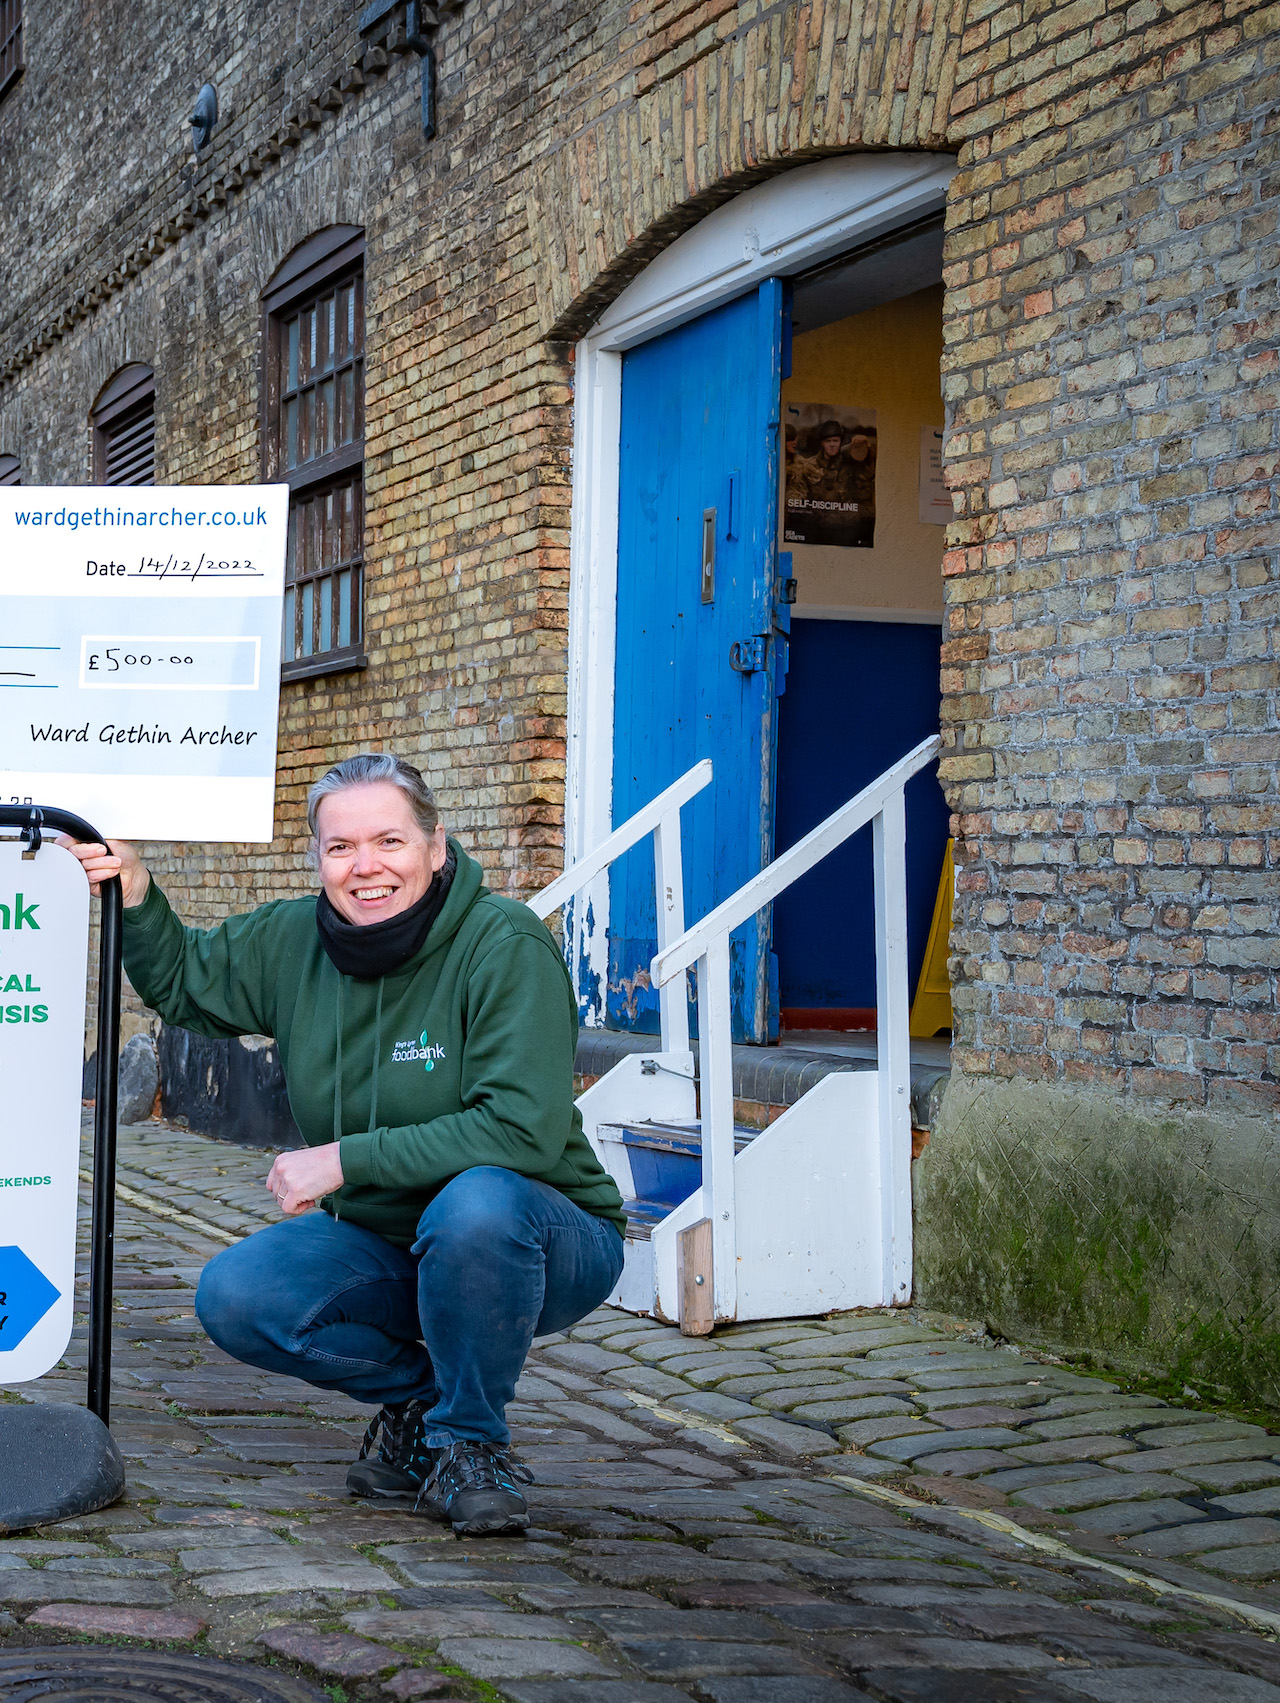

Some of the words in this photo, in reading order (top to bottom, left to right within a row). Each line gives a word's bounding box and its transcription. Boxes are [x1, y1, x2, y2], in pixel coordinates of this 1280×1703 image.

[787, 498, 859, 512] SELF-DISCIPLINE
[14, 506, 268, 531] wardgethinarcher.co.uk
[86, 561, 126, 577] Date
[138, 553, 257, 582] 14/12/2022
[30, 723, 90, 743] Ward
[99, 724, 172, 746] Gethin
[180, 726, 257, 746] Archer
[391, 1043, 446, 1062] foodbank
